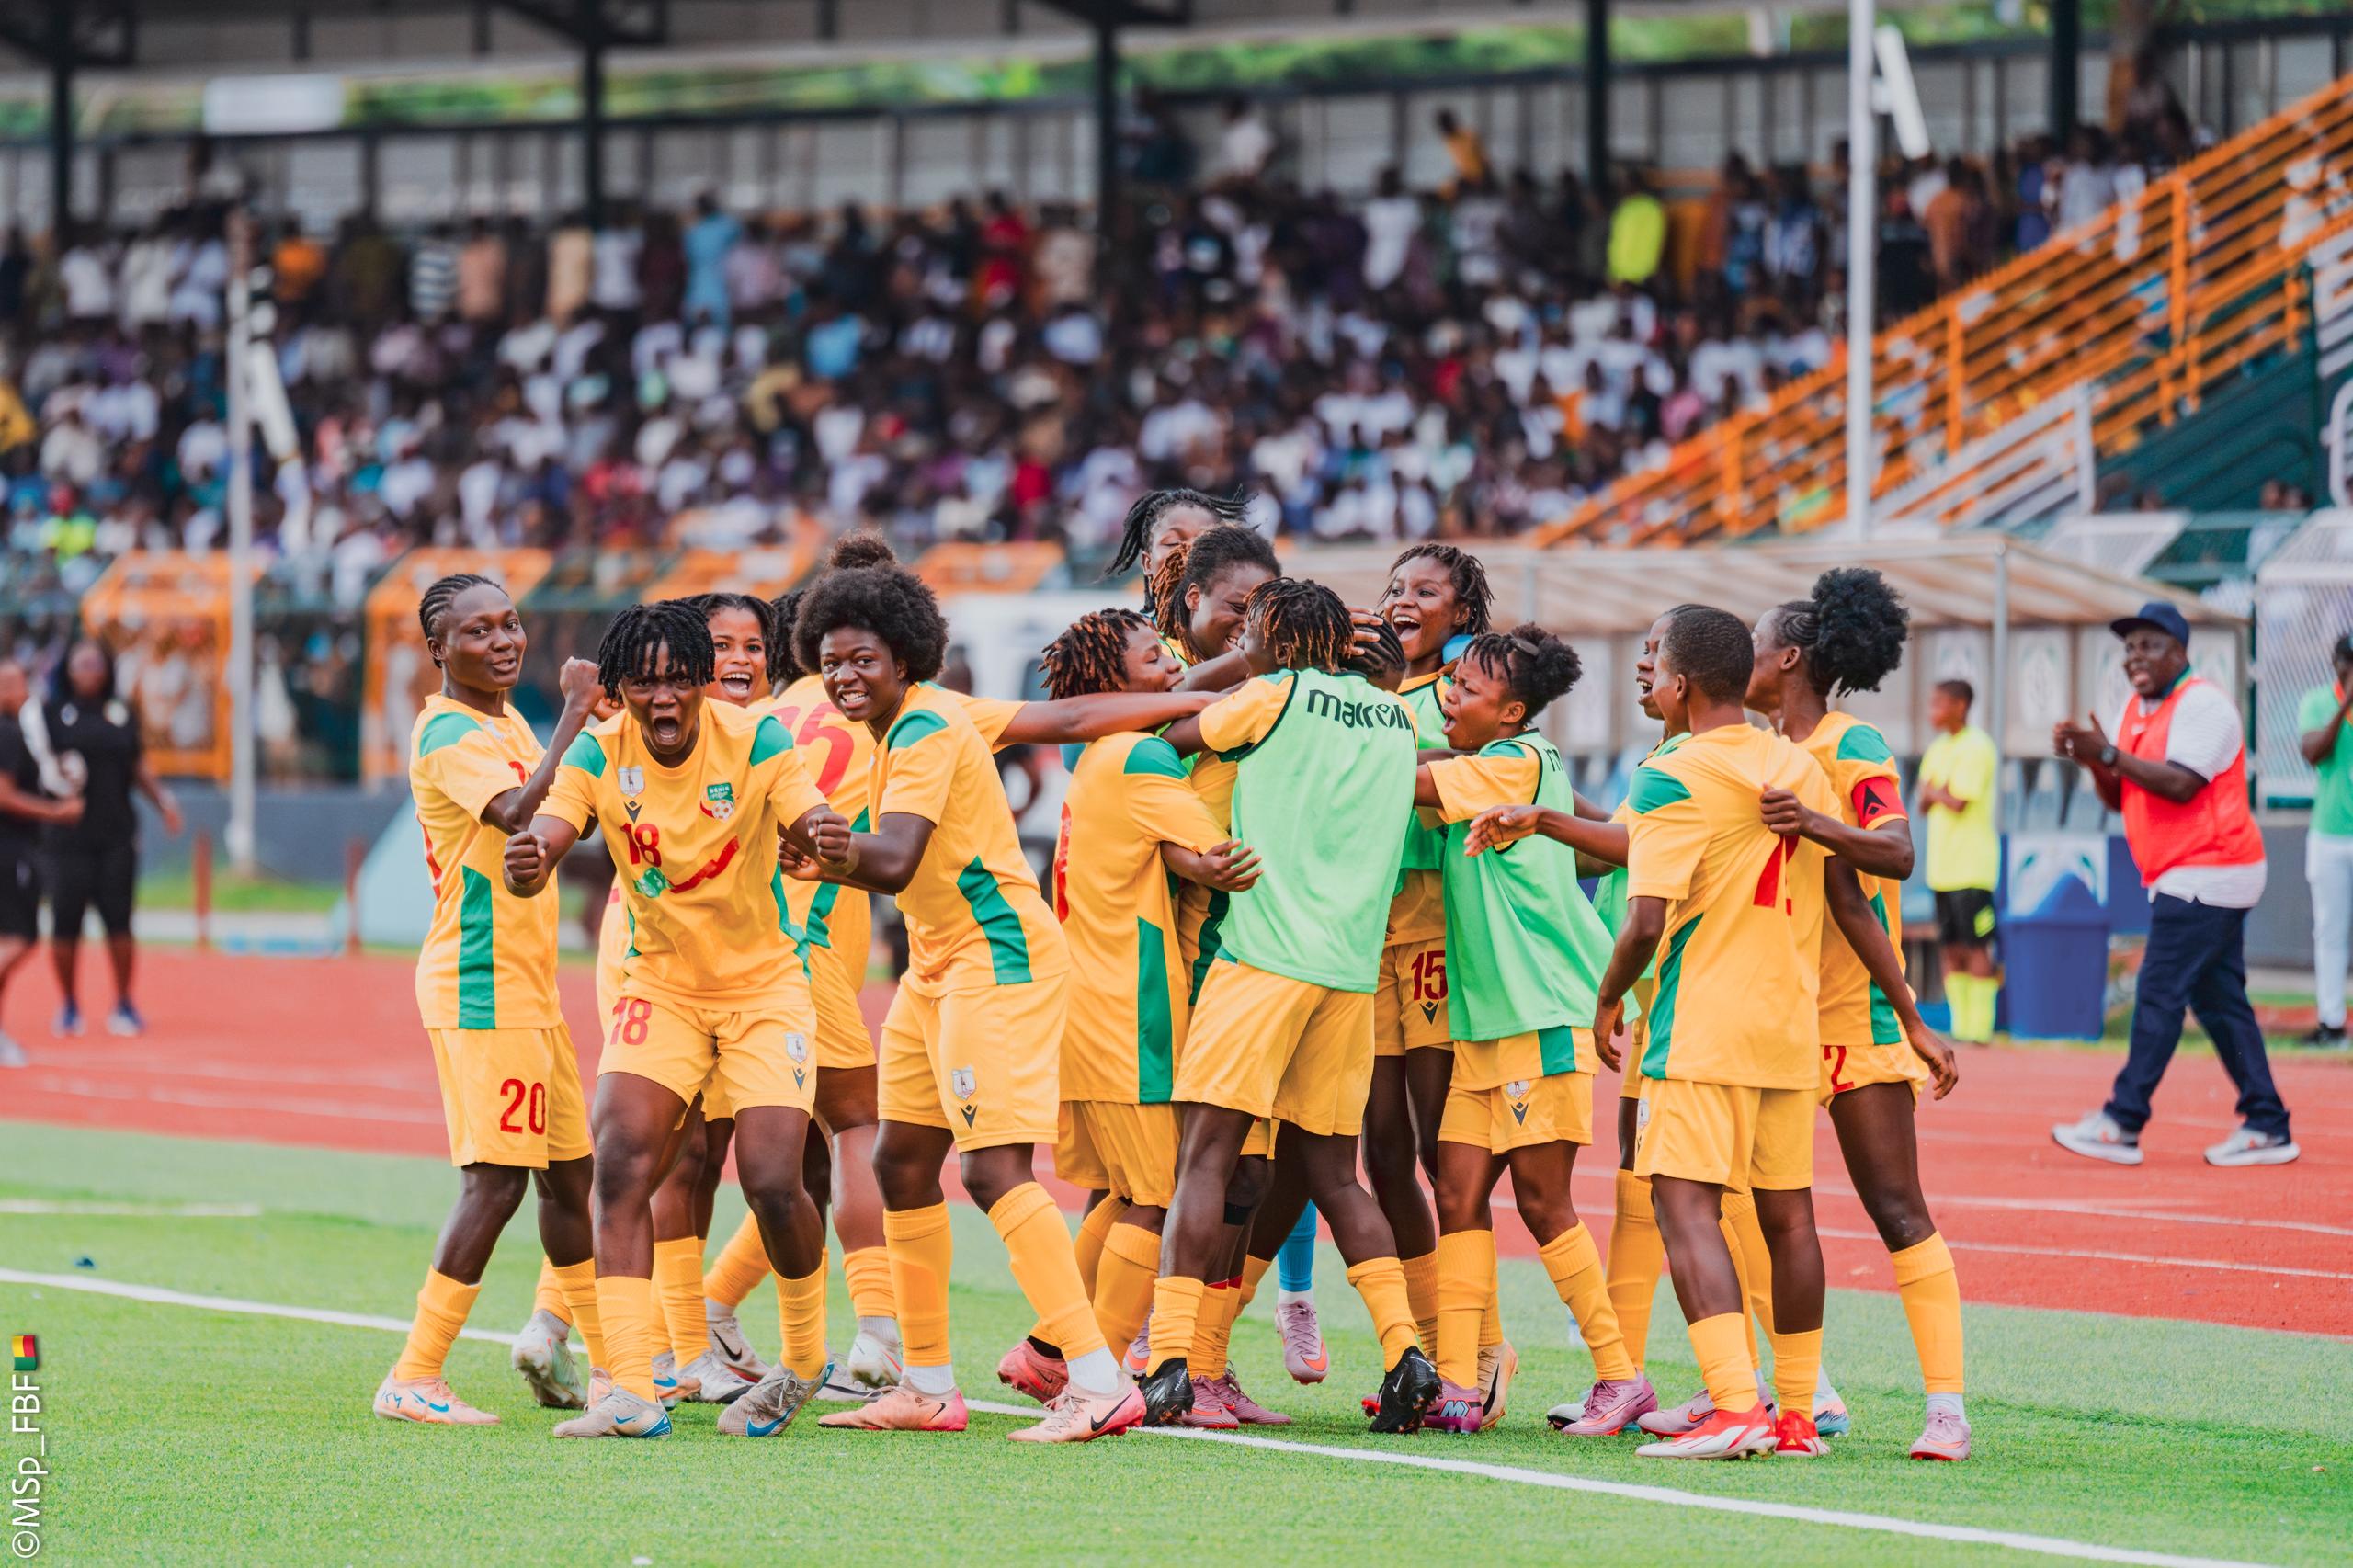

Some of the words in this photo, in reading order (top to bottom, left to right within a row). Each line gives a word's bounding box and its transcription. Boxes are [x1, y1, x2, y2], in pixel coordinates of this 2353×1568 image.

[619, 823, 662, 867] 18
[1410, 949, 1449, 1001] 15
[610, 996, 653, 1046] 18
[499, 1078, 546, 1135] 20
